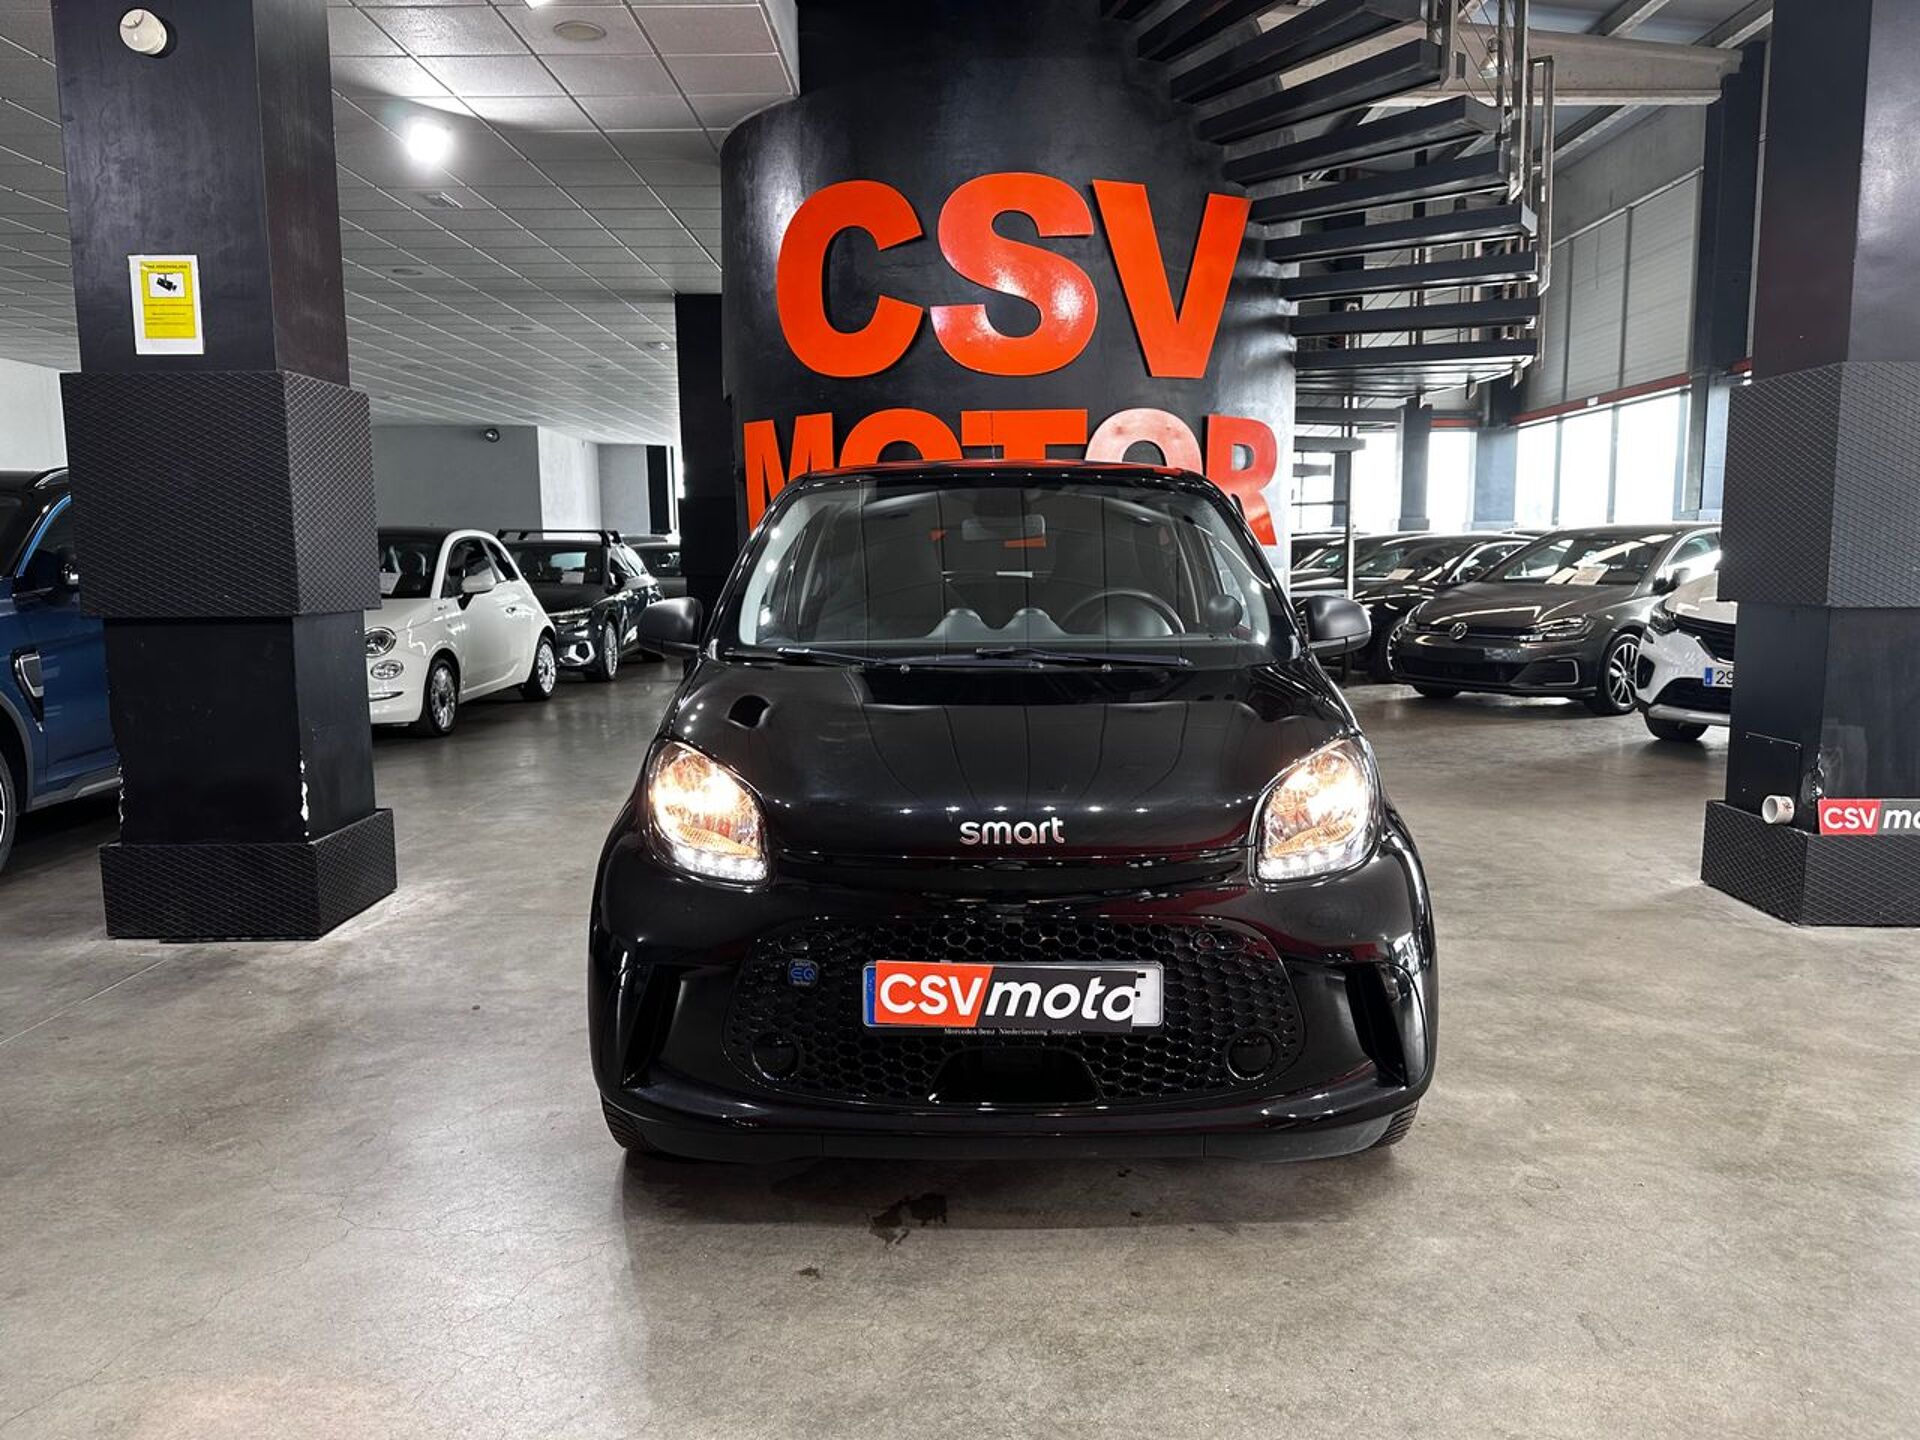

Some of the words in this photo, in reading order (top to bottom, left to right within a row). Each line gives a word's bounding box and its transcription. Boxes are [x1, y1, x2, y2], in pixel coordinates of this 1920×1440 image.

[776, 172, 1252, 379] CSV
[959, 816, 1066, 846] smart
[1823, 807, 1878, 829] CSV
